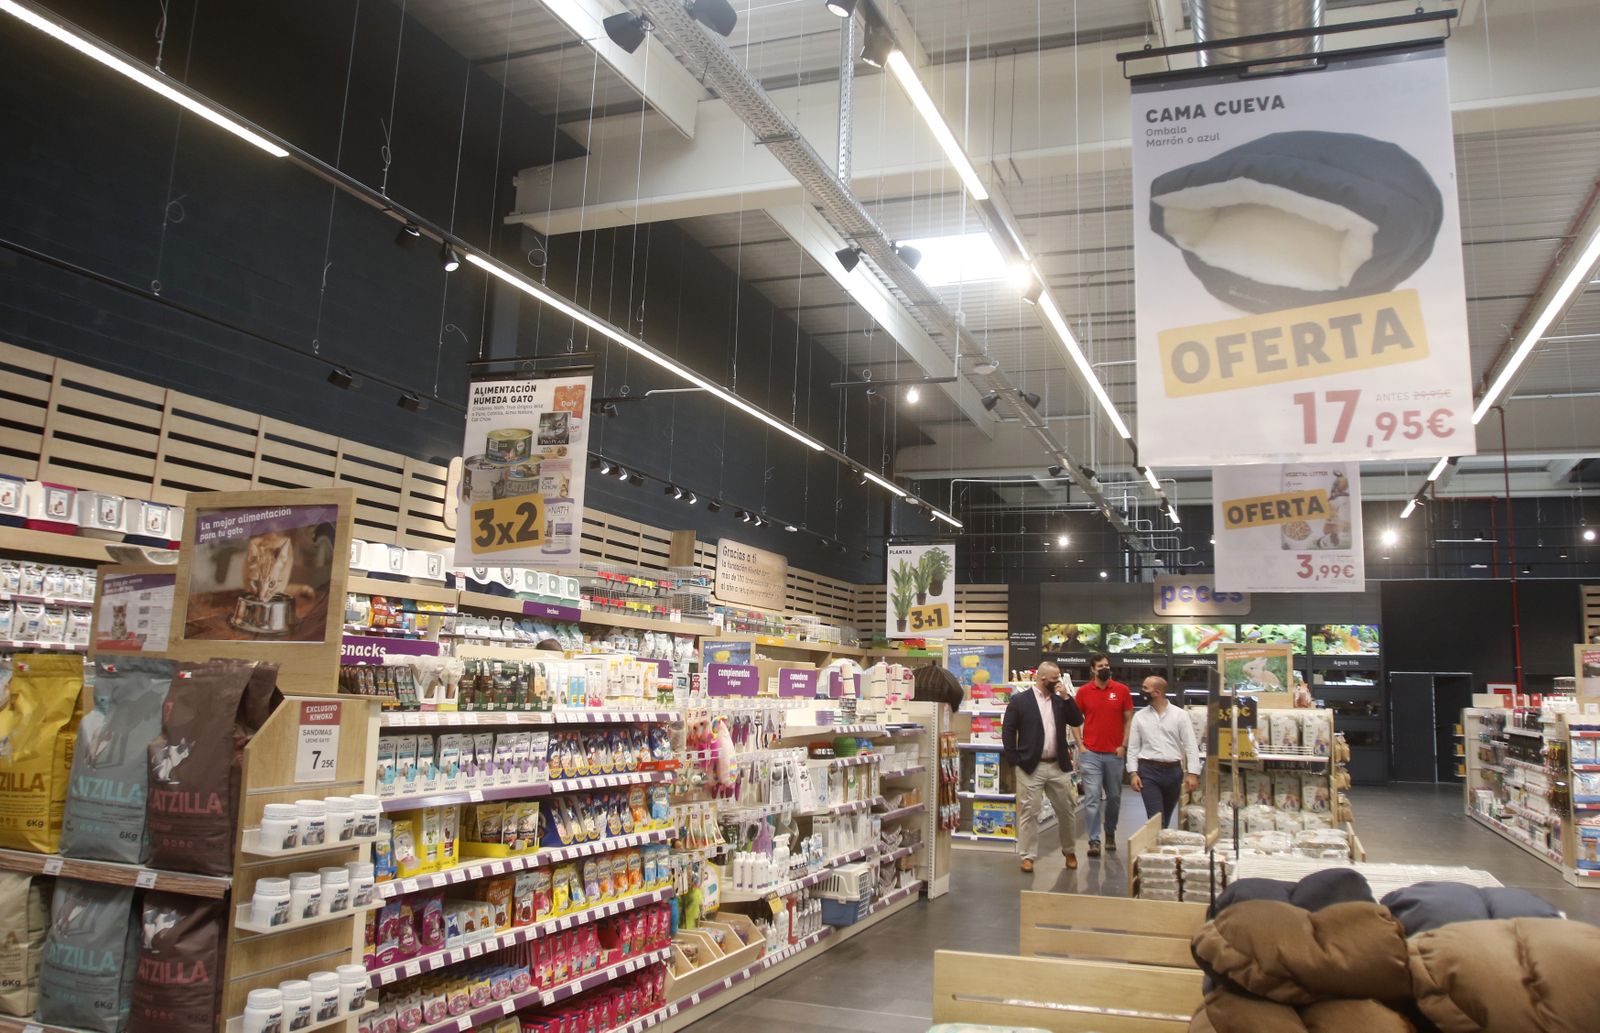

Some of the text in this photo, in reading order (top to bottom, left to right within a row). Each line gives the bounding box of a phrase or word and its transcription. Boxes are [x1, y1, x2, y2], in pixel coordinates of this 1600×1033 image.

[1145, 94, 1285, 124] CAMA CUEVA
[1145, 125, 1187, 137] Ombala
[1145, 134, 1184, 148] Marrón
[1197, 132, 1220, 144] azul
[1171, 306, 1415, 384] OFERTA
[474, 382, 537, 395] ALIMENTACIÓN
[473, 394, 534, 405] HÚMEDA GATO
[1375, 392, 1410, 402] ANTES
[551, 506, 569, 514] NATH
[1227, 495, 1325, 525] OFERTA
[201, 507, 292, 531] La mejor alimentación
[474, 501, 539, 548] 3x2
[199, 526, 244, 543] para tu gato
[722, 545, 757, 565] Gracias a ti
[1296, 553, 1355, 581] 3,99€
[1160, 585, 1243, 610] peces
[911, 607, 943, 630] 3+1
[340, 643, 387, 658] snacks
[718, 668, 750, 679] complementos
[306, 704, 338, 713] EXCLUSIVO
[26, 819, 44, 828] 6Kg
[119, 831, 138, 841] 6Kg
[2, 979, 21, 987] 6Kg
[94, 1000, 113, 1009] 6Kg
